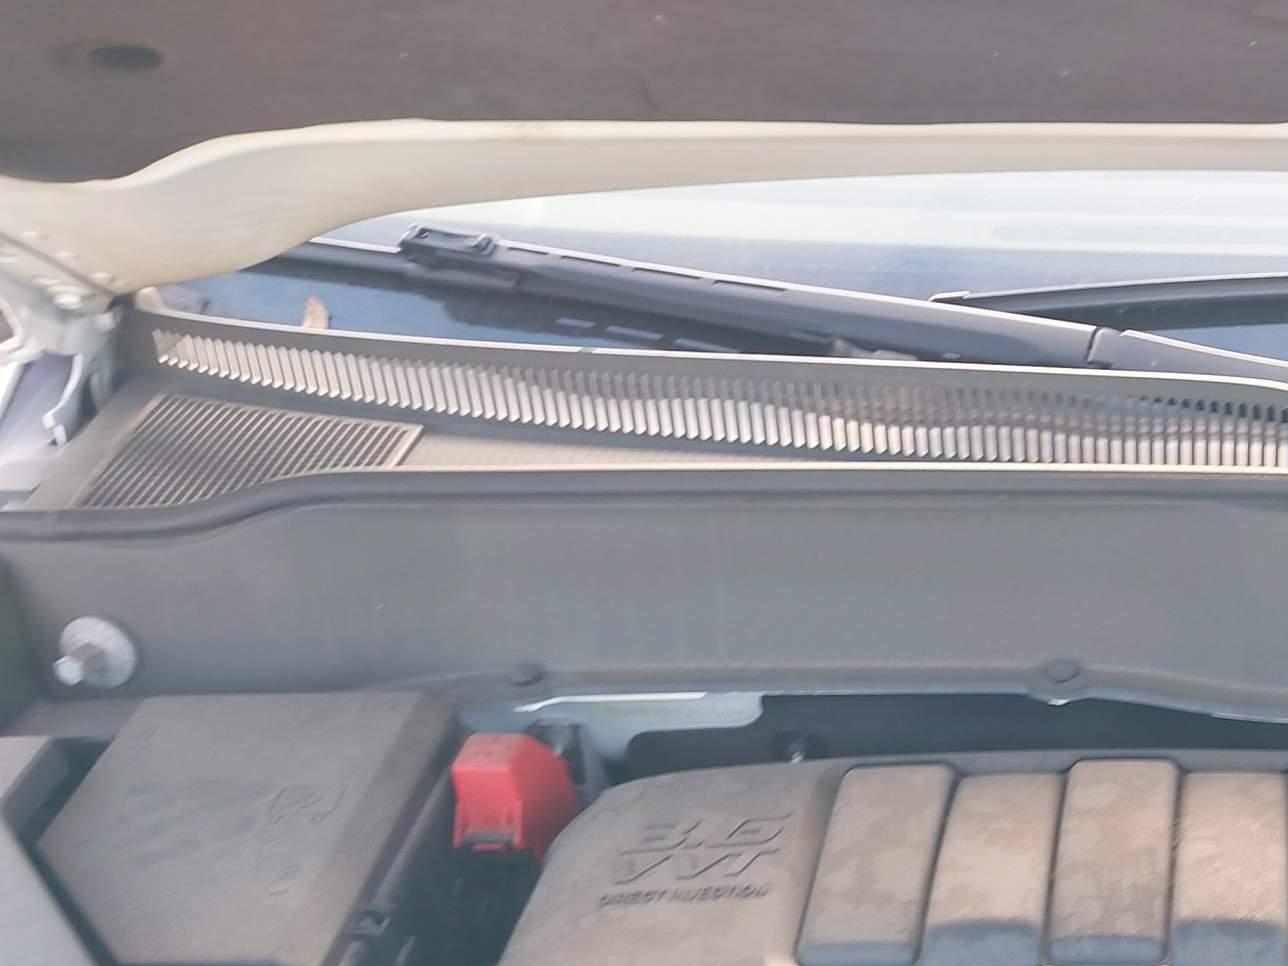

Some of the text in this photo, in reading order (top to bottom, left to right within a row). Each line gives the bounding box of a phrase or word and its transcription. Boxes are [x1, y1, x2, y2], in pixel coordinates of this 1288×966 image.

[620, 811, 793, 855] 3.6
[612, 847, 782, 886] VVT
[597, 882, 771, 908] DIRECT INJECTION
